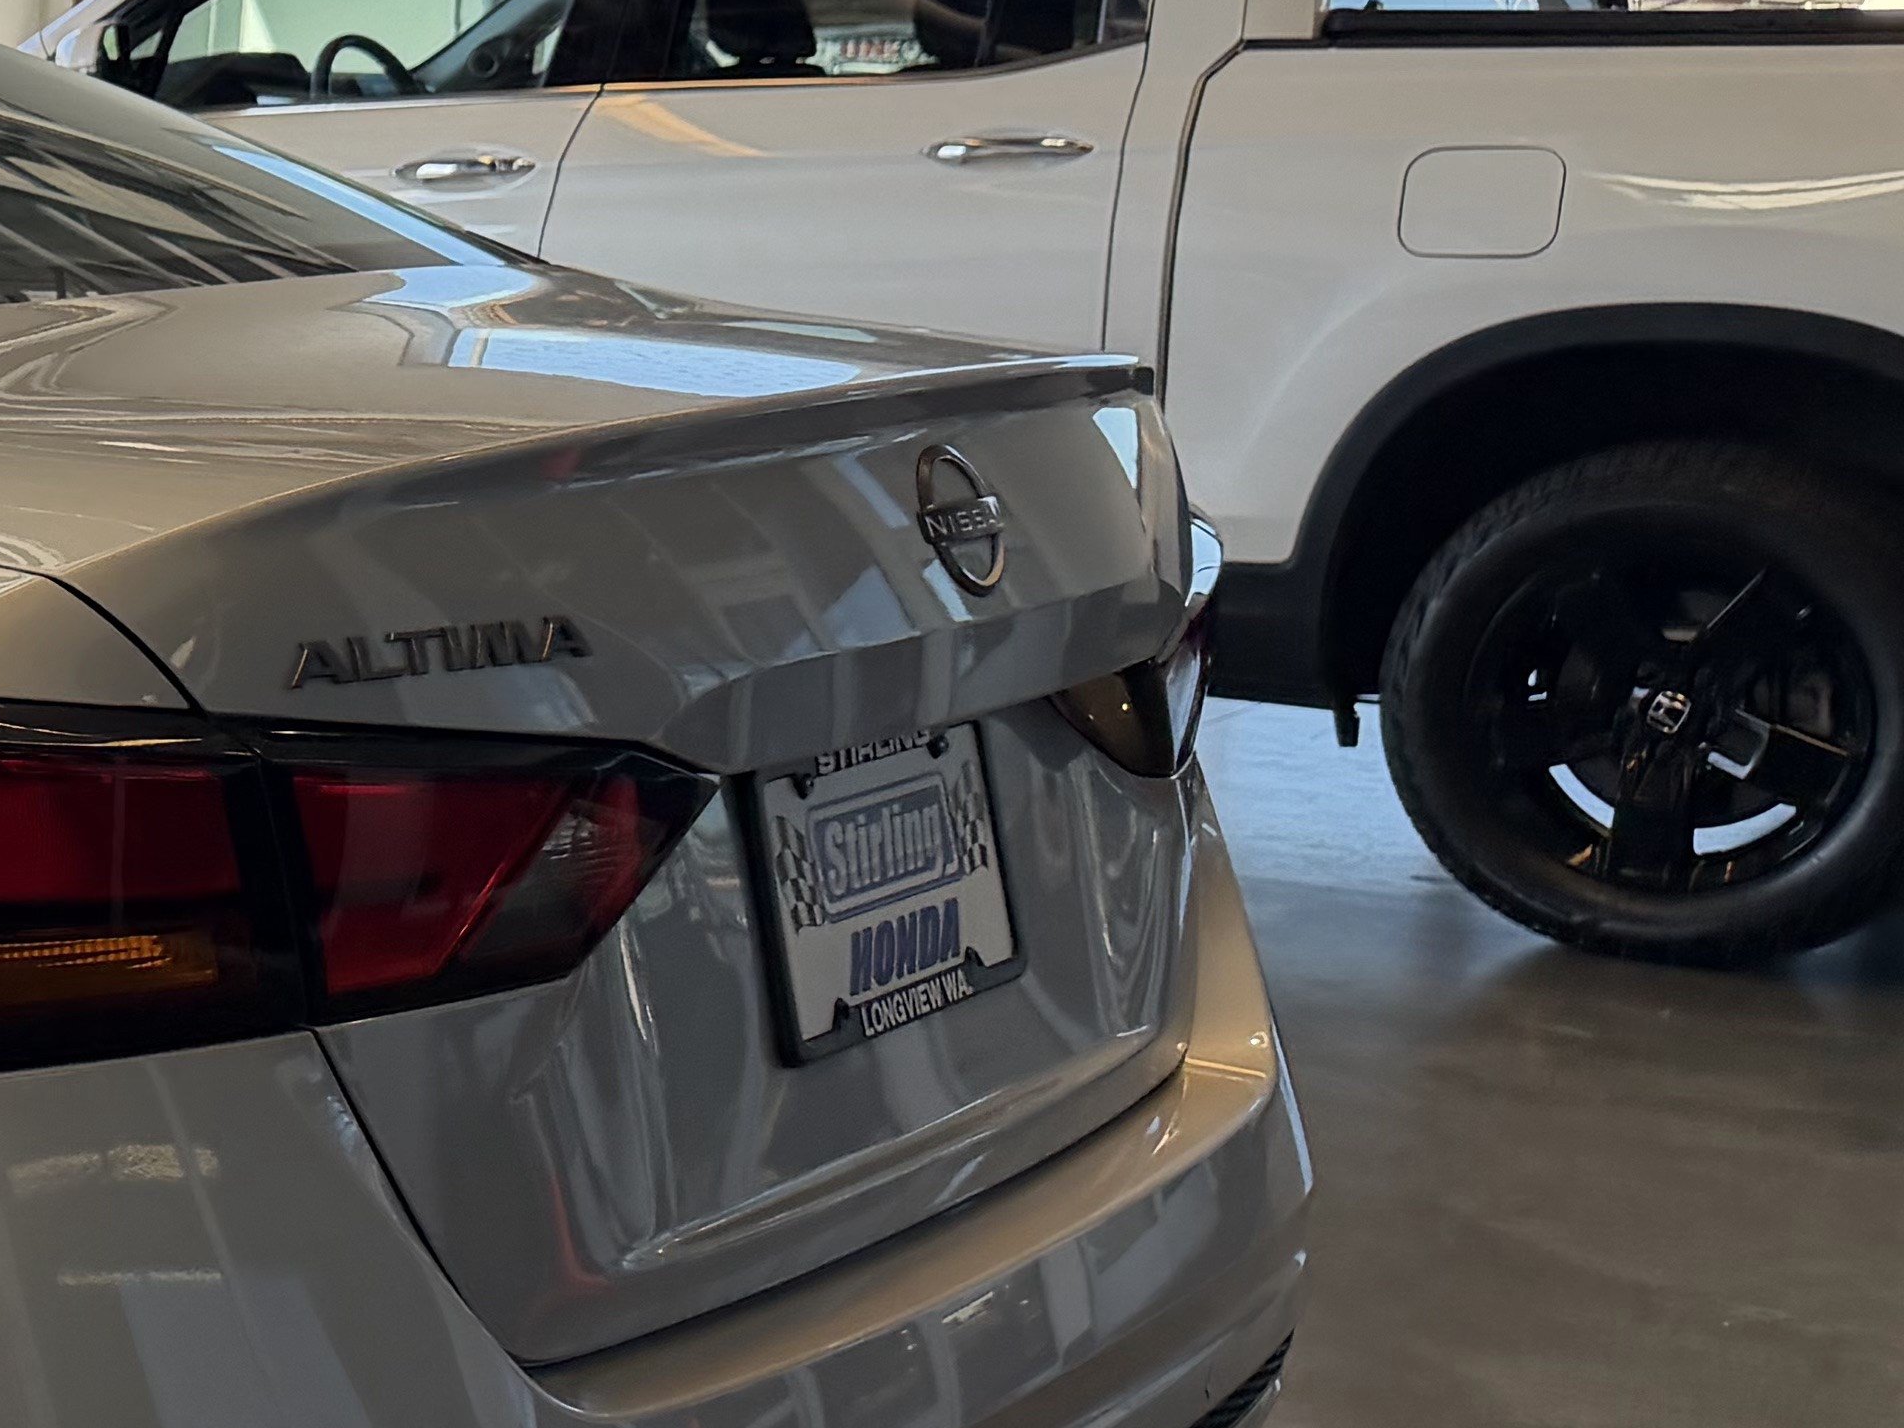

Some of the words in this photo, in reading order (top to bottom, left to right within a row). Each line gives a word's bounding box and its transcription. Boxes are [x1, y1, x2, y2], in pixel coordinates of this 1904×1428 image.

[924, 506, 1005, 539] NISS
[290, 616, 591, 689] ALTIMA
[824, 802, 958, 896] Stirling
[849, 897, 961, 997] HONDA
[861, 976, 943, 1037] LONGVIEW
